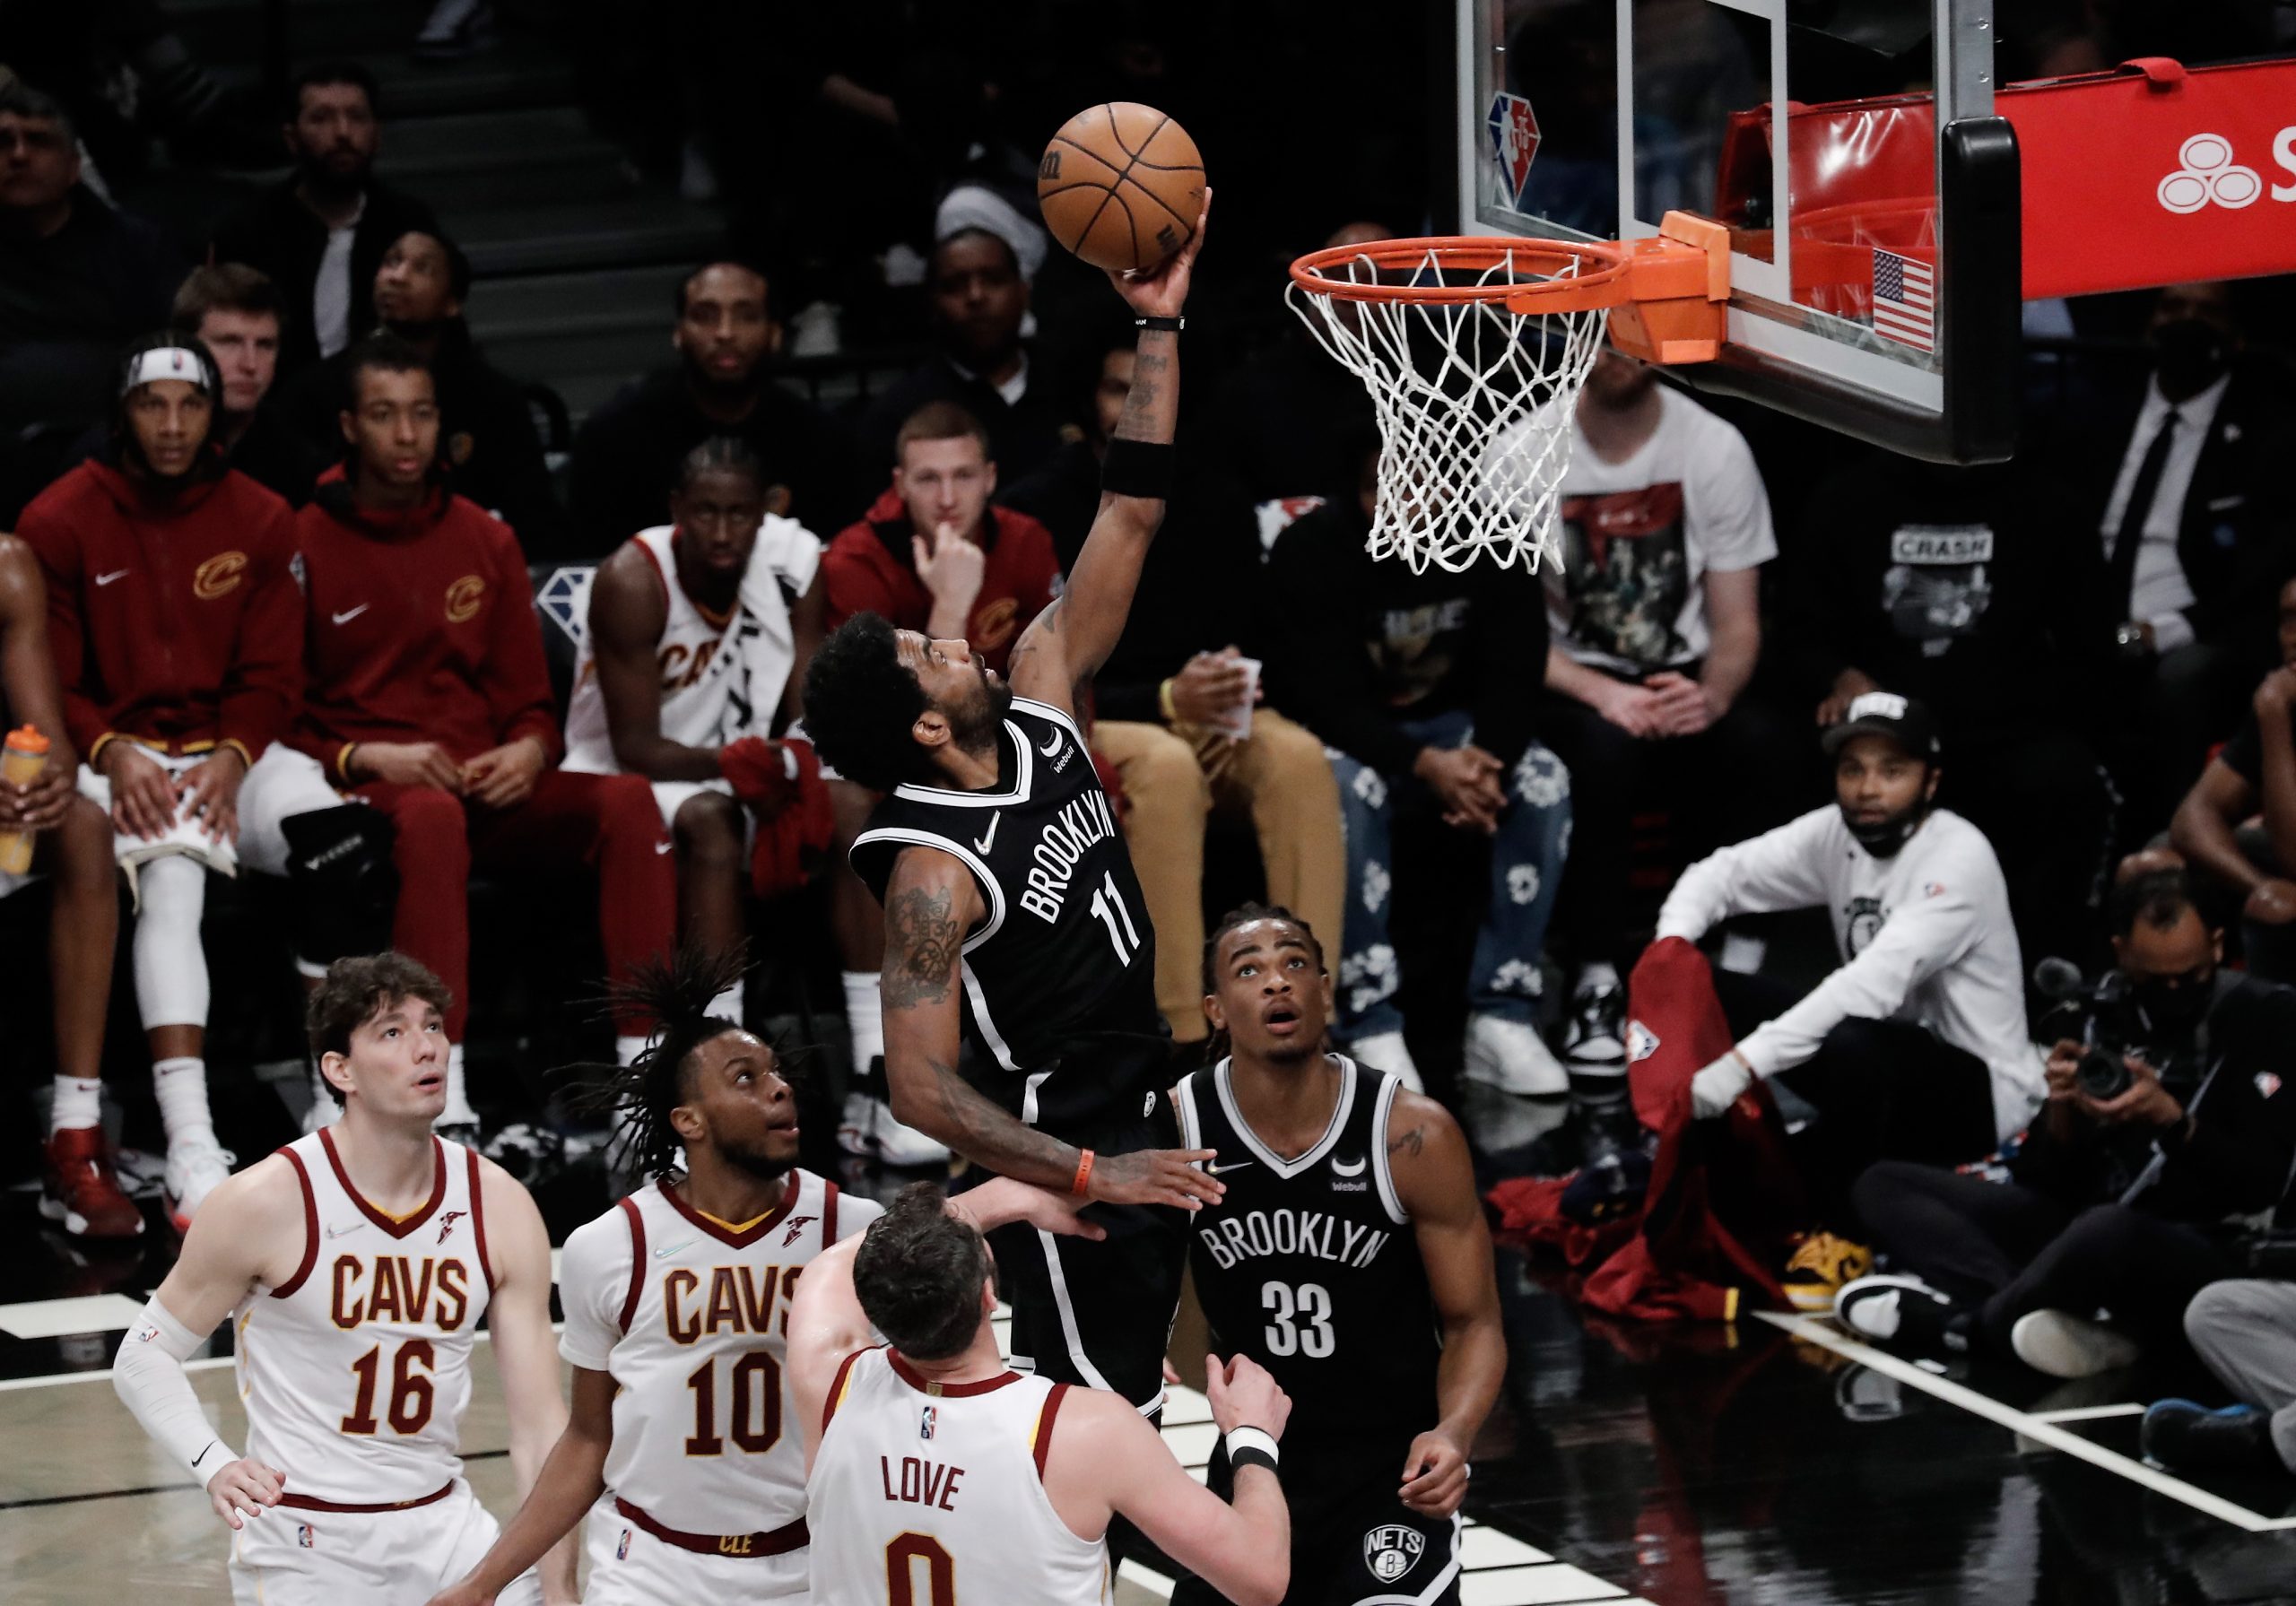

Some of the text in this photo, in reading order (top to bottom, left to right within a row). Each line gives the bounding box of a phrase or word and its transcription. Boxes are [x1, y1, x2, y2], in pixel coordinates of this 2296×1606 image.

[1053, 745, 1074, 774] Webull
[1020, 789, 1116, 925] BROOKLYN
[1090, 869, 1141, 968] 11
[1332, 1181, 1368, 1192] Webull
[1199, 1208, 1391, 1270] BROOKLYN
[331, 1254, 469, 1333] CAVS
[1261, 1280, 1336, 1359] 33
[340, 1338, 435, 1436] 16
[684, 1350, 784, 1458] 10
[881, 1454, 966, 1513] LOVE
[718, 1534, 753, 1554] CLE
[1367, 1527, 1421, 1555] NETS
